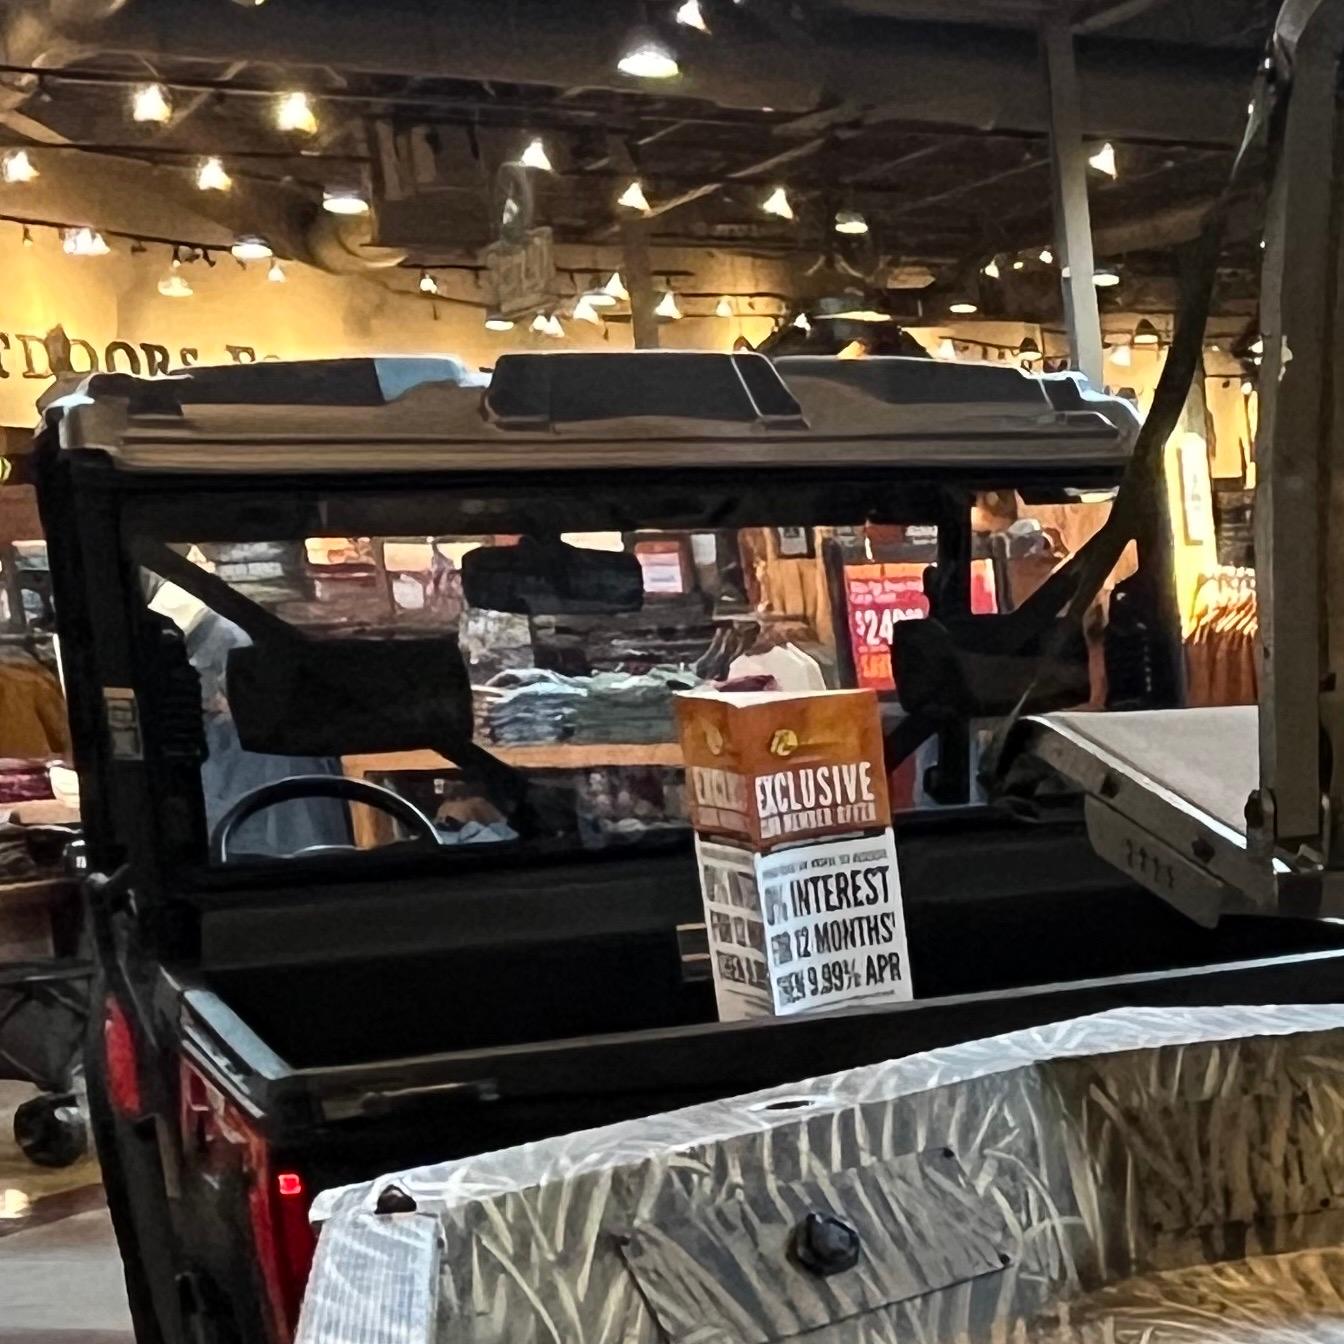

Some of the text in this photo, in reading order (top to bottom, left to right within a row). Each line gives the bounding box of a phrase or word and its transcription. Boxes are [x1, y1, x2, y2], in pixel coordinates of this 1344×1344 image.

[755, 761, 875, 819] EXCLUSIVE
[790, 865, 890, 918] INTEREST
[866, 952, 902, 986] APR
